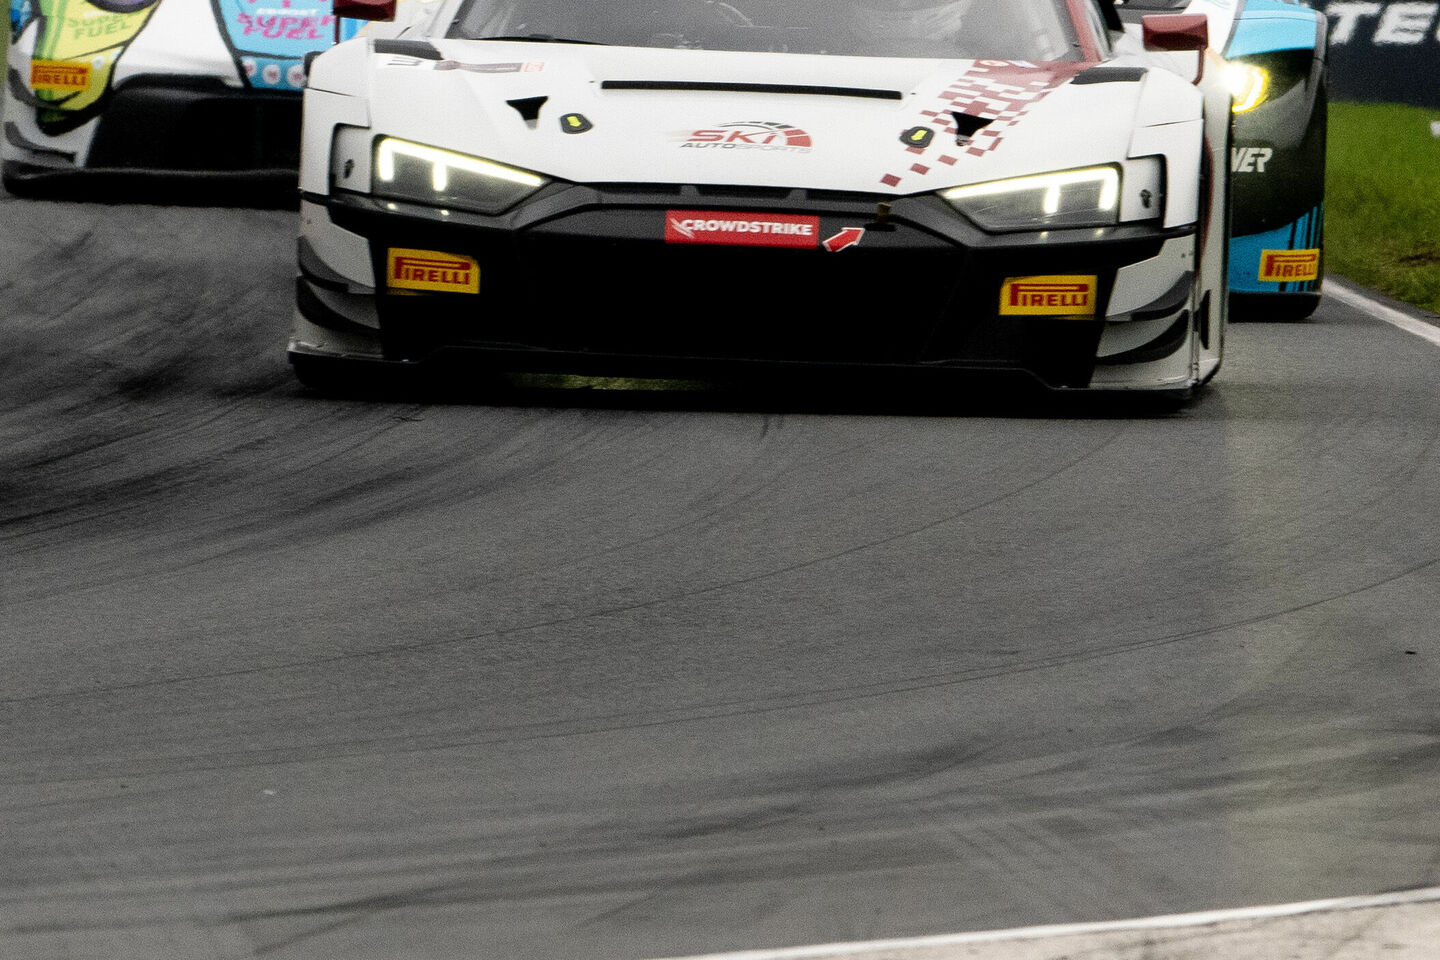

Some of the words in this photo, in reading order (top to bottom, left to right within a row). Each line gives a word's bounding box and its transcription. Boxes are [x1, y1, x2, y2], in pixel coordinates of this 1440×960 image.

[74, 22, 132, 40] FUEL
[1300, 1, 1440, 45] TE
[32, 64, 89, 86] PIRELLI
[681, 218, 814, 237] CROWDSTRIKE
[392, 253, 473, 287] PIRELLI
[1264, 252, 1318, 277] PIRELLI
[1008, 280, 1094, 310] PIRELLI
